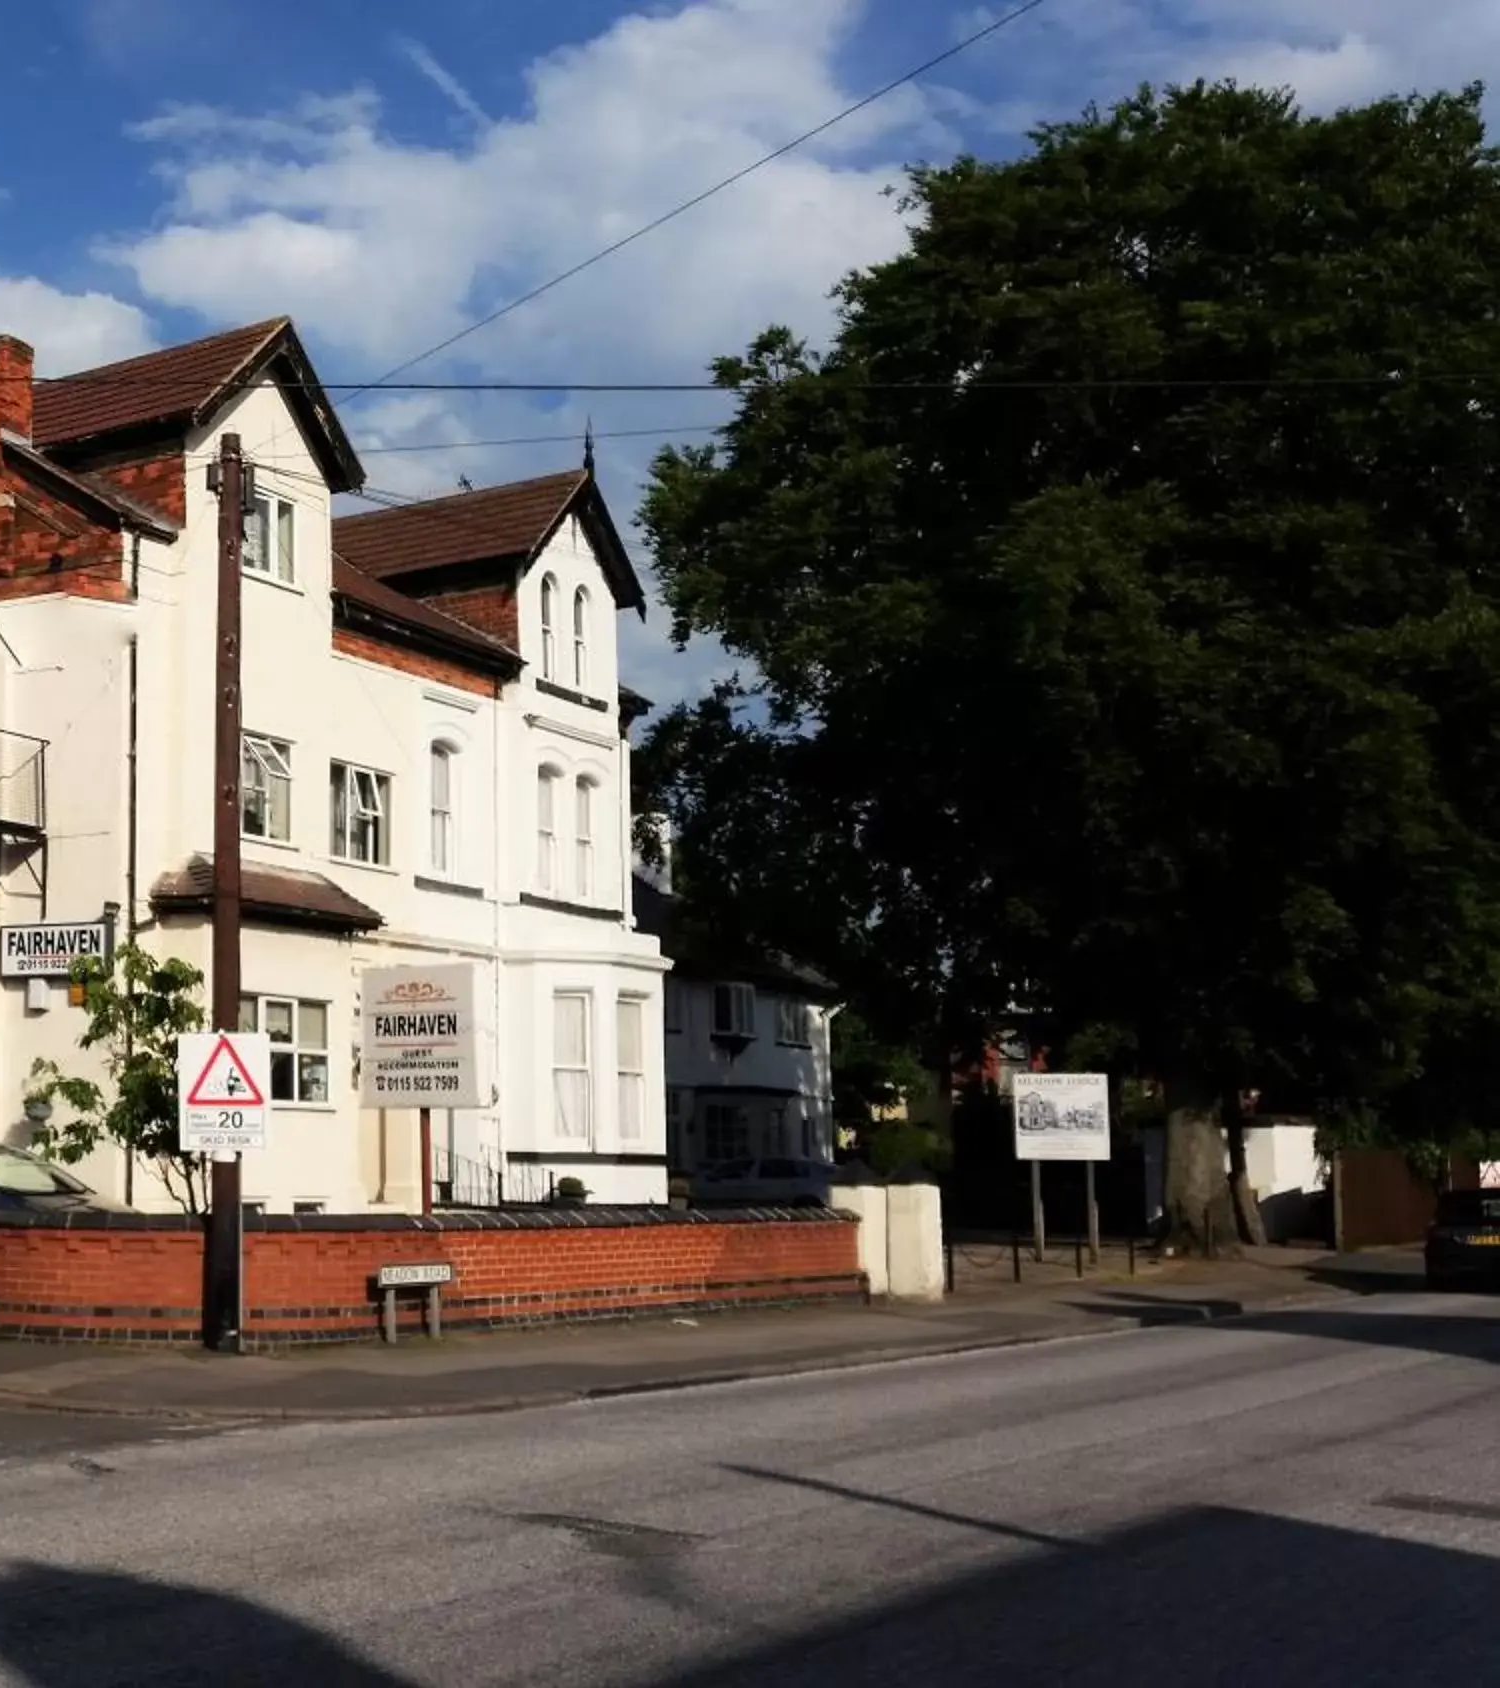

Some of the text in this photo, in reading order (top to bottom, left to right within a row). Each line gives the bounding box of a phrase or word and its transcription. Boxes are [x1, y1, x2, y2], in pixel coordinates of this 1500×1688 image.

[6, 929, 100, 956] FAIRHAVEN
[375, 1014, 457, 1036] FAIRHAVEN
[387, 1075, 411, 1091] 0115
[218, 1111, 243, 1129] 20
